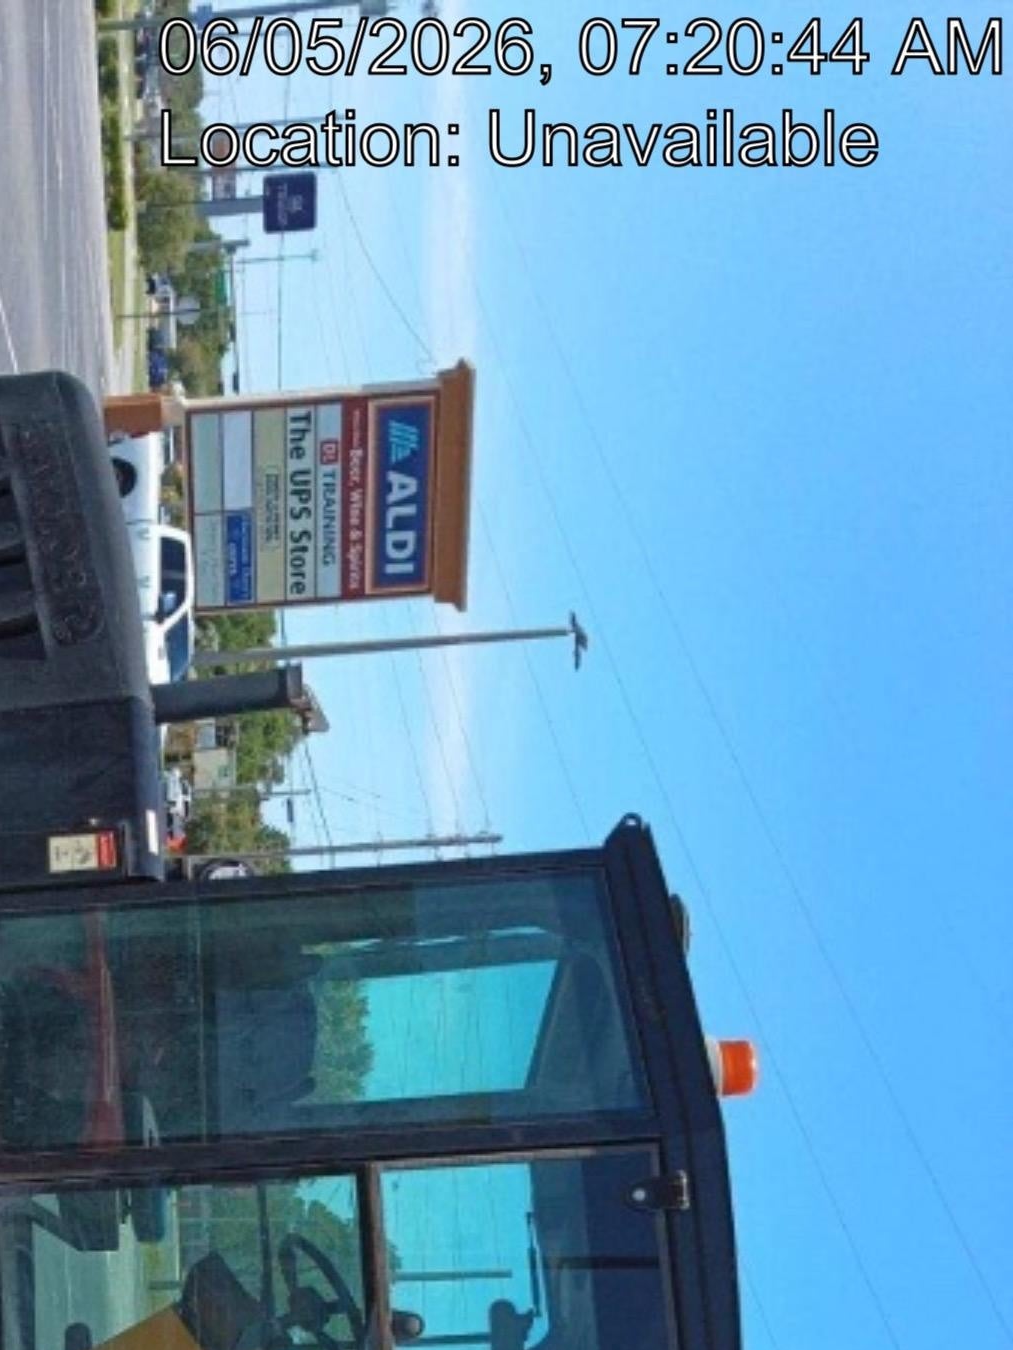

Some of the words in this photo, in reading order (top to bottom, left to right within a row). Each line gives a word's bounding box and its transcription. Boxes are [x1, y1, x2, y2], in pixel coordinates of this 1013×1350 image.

[290, 411, 312, 460] The
[290, 469, 312, 520] UPS
[322, 469, 336, 567] TRAINING
[349, 489, 362, 526] Wine
[385, 470, 418, 575] ALDI
[290, 530, 312, 595] Store
